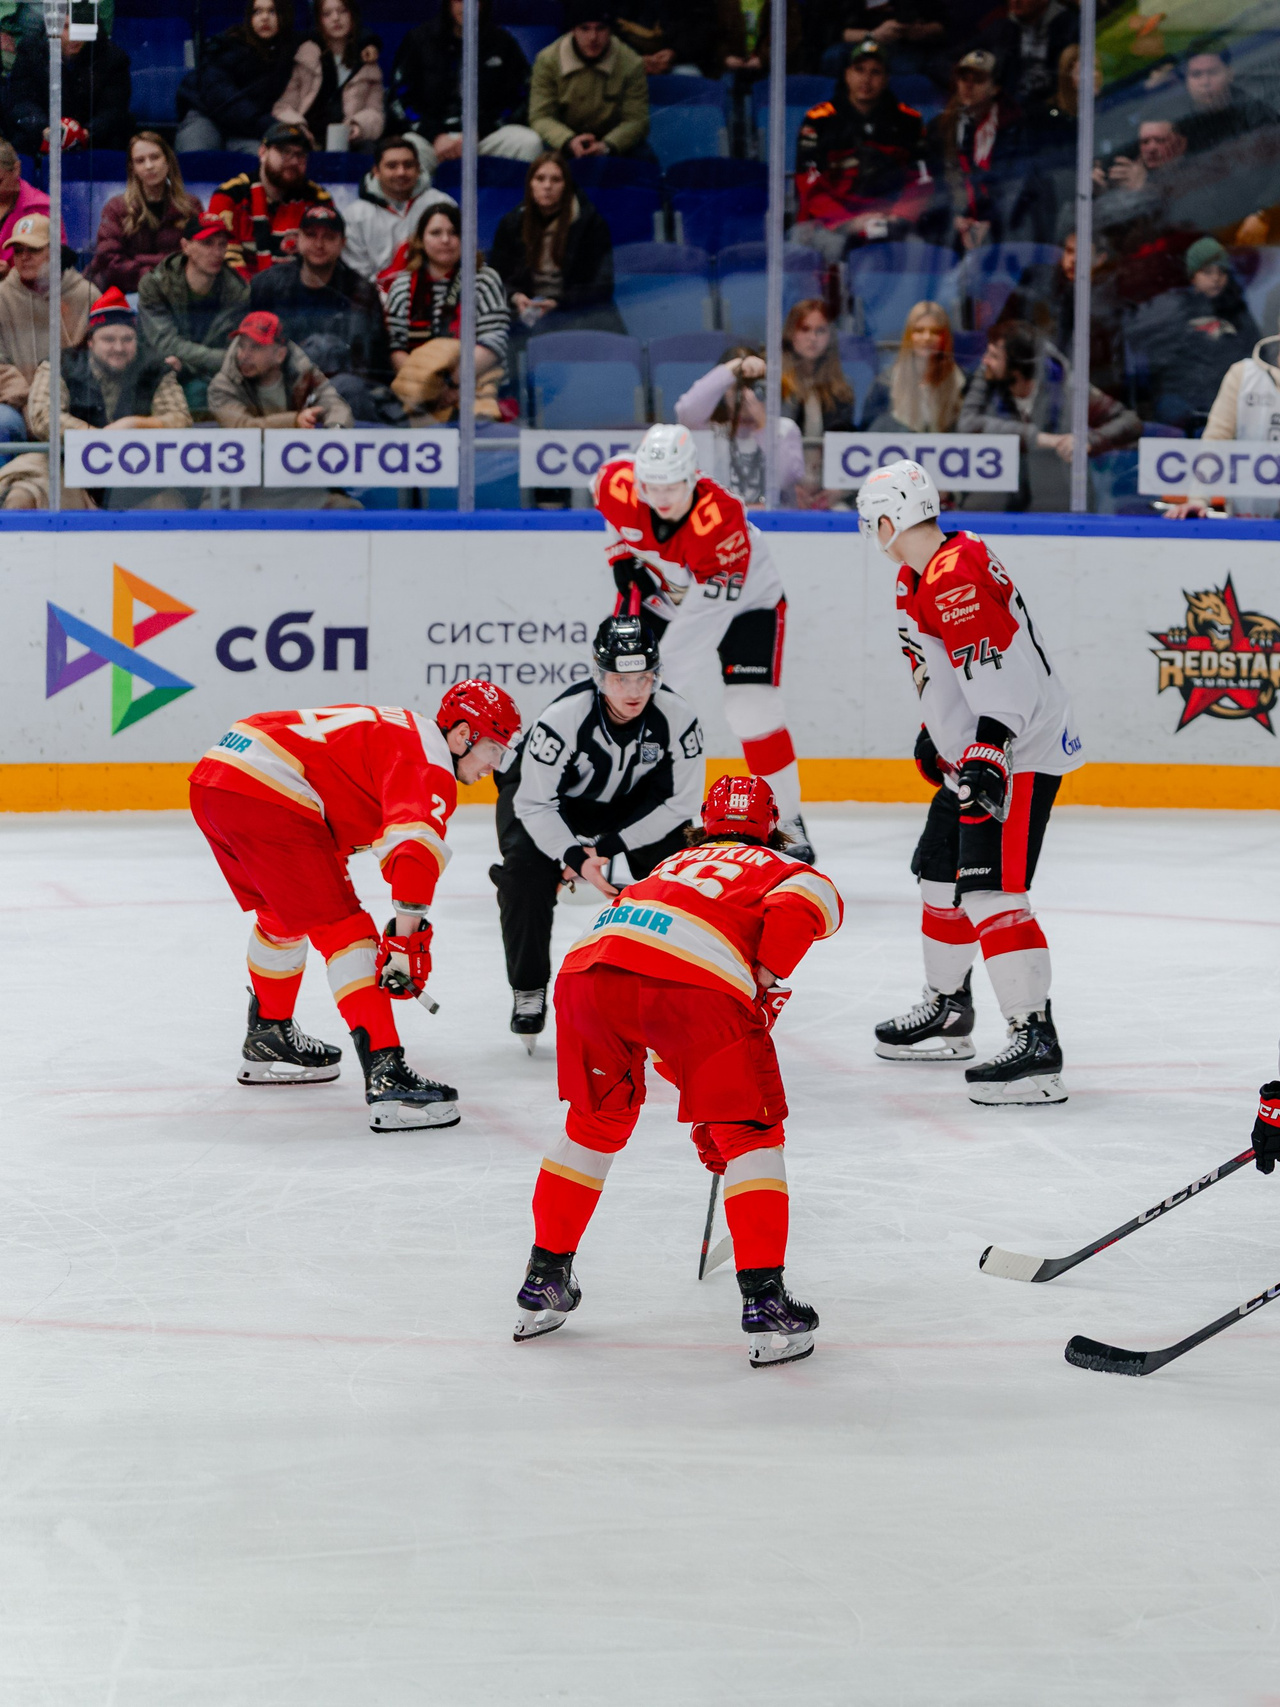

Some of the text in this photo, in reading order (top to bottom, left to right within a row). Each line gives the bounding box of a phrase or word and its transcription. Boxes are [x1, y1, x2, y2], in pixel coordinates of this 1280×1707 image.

[81, 441, 246, 475] согаз
[281, 441, 442, 475] согаз
[920, 499, 935, 516] 74
[703, 570, 744, 601] 56
[216, 610, 368, 672] сбп
[427, 622, 587, 645] система
[427, 662, 589, 685] платеже
[951, 637, 1004, 681] 74
[217, 731, 253, 754] BUR
[529, 725, 562, 763] 96
[593, 905, 674, 935] SIBUR
[256, 1041, 283, 1061] CCM
[1138, 1167, 1220, 1224] CCM
[546, 1286, 561, 1306] CCM
[765, 1300, 801, 1329] CCM
